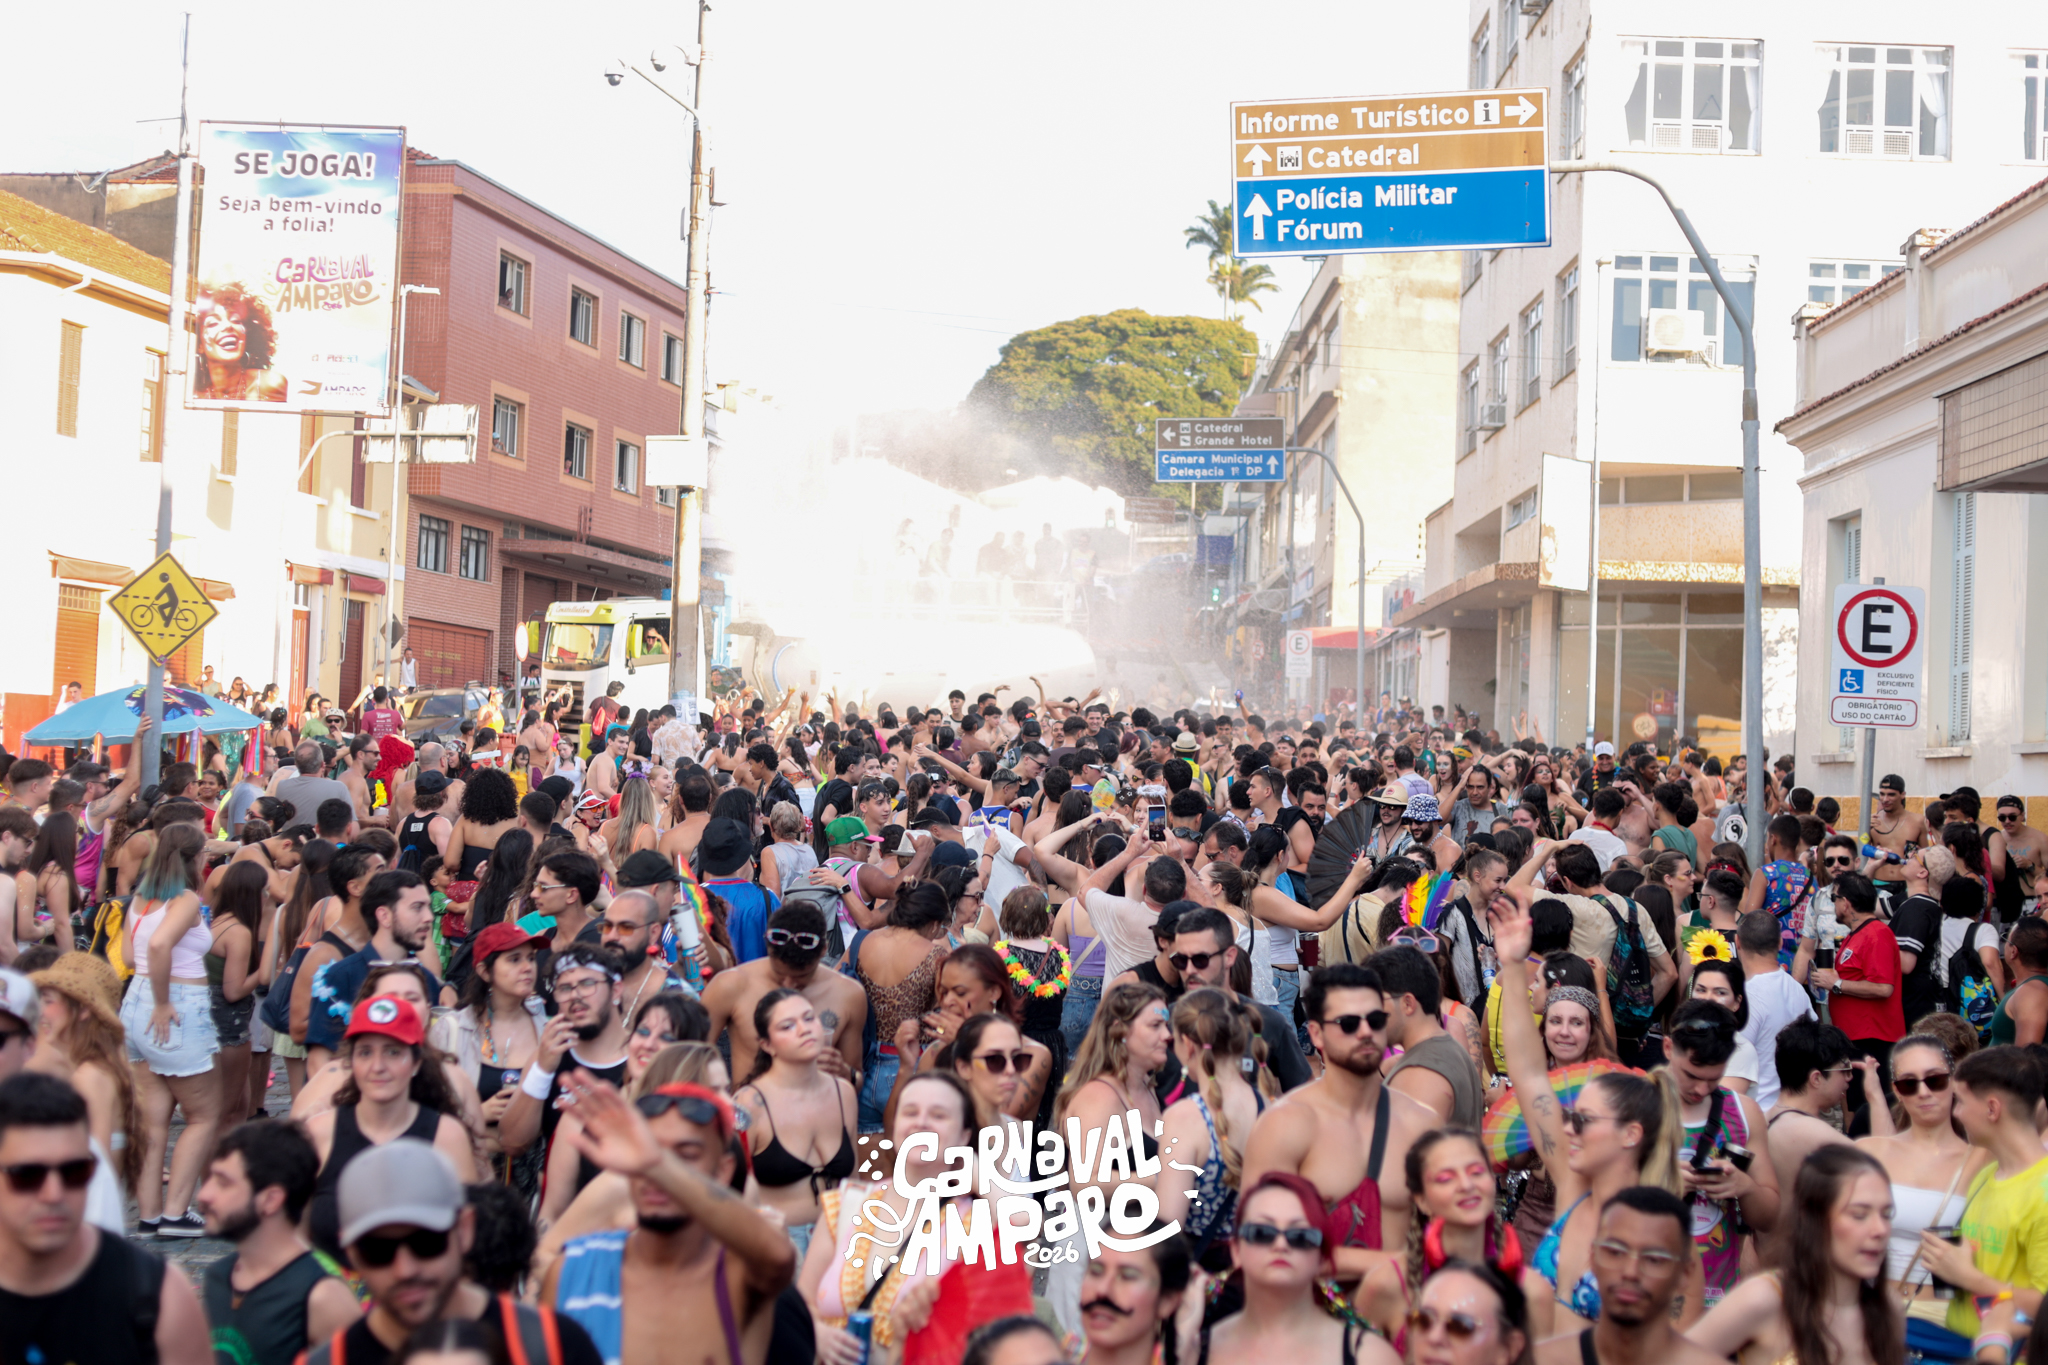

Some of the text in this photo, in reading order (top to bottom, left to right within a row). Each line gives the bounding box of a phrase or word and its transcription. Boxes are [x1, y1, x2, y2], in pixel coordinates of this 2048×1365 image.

[1241, 112, 1339, 134] Informe
[1351, 104, 1469, 129] Turístico
[1307, 143, 1419, 168] Catedral
[234, 152, 373, 178] SE JOGA!
[1276, 184, 1458, 211] Polícia Militar
[219, 195, 382, 215] Seja bem-vindo
[263, 217, 334, 233] a folia!
[1277, 219, 1363, 241] Fórum
[1194, 423, 1243, 433] Catedral
[1194, 436, 1272, 445] Grande Hotel
[1211, 454, 1263, 465] Municipal
[1170, 467, 1224, 478] Delegacia
[1246, 467, 1262, 476] DP
[1862, 604, 1894, 654] E
[1295, 637, 1303, 650] E
[1877, 672, 1915, 680] EXCLUSIVO
[1877, 680, 1915, 688] DEFICIENTE
[1848, 701, 1902, 711] OBRIGATÓRIO
[1860, 712, 1871, 720] DO
[1873, 713, 1906, 722] CARTÃO
